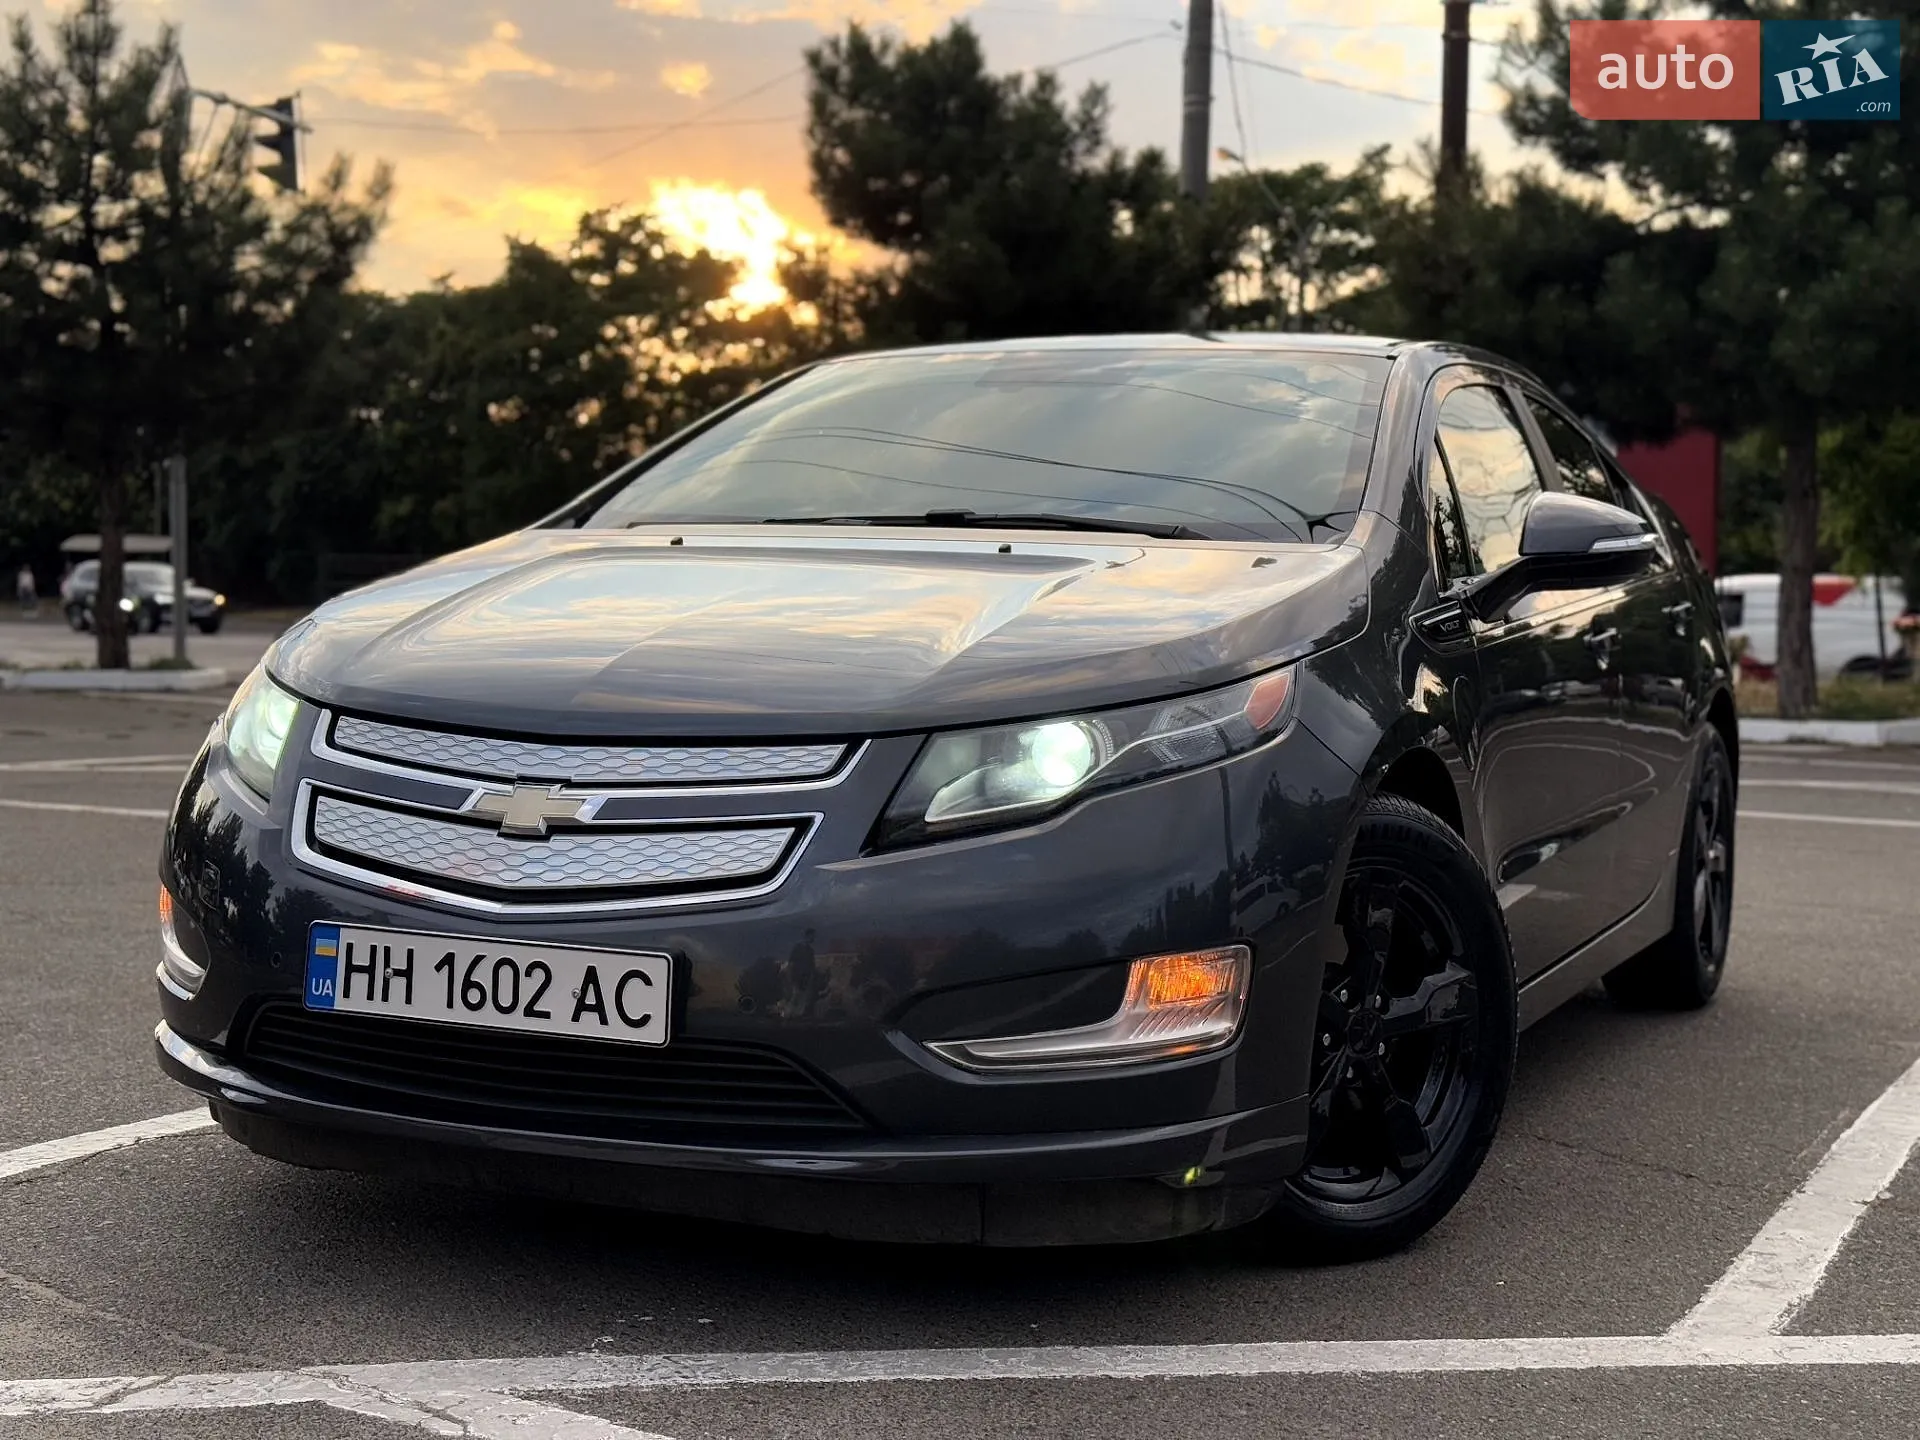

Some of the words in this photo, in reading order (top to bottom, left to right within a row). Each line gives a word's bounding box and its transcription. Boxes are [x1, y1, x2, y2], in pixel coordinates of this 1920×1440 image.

[311, 977, 333, 997] UA
[342, 942, 414, 1005] HH
[434, 951, 551, 1020] 1602
[571, 965, 653, 1029] AC
